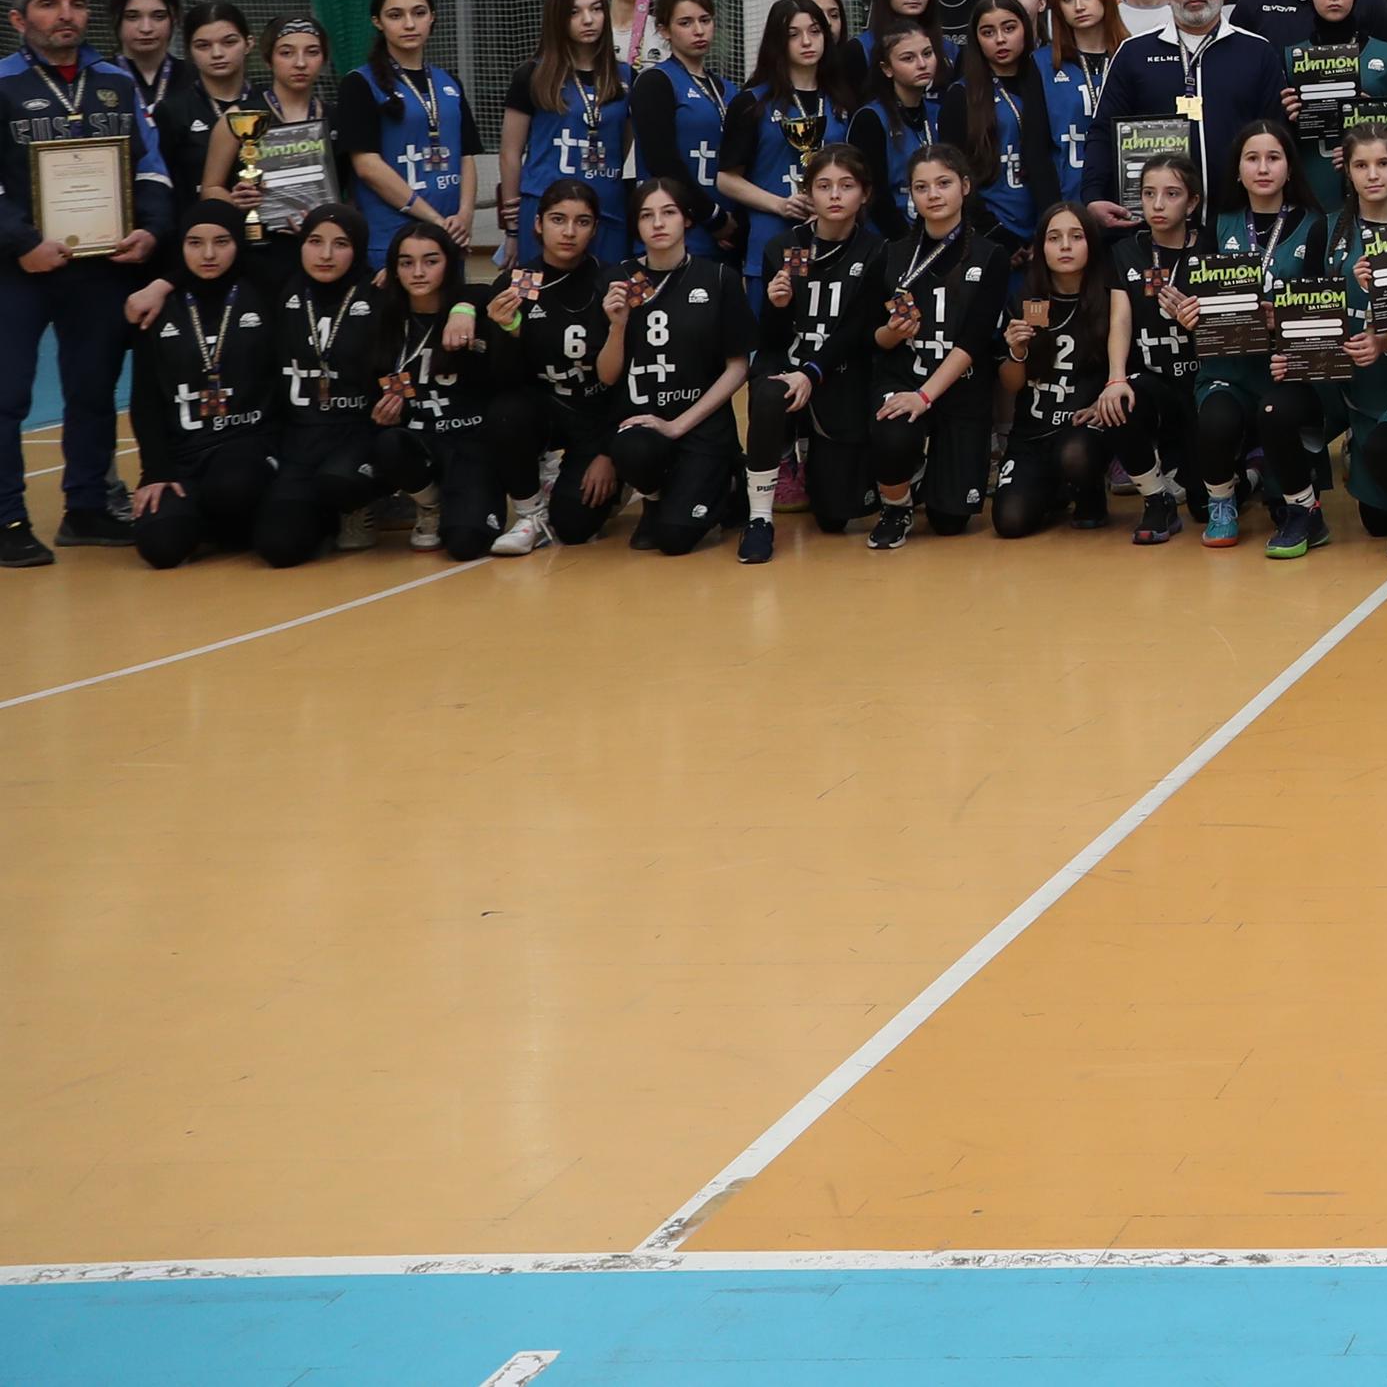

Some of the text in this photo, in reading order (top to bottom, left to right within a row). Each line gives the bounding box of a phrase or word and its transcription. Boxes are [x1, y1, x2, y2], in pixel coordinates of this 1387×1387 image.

[1146, 55, 1181, 63] KELME
[1294, 52, 1359, 74] ДИПЛОМ
[1122, 128, 1189, 151] ДИПЛОМ
[1189, 260, 1262, 284] ДИПЛОМ
[808, 280, 842, 317] 11
[933, 286, 947, 324] 1
[1274, 283, 1346, 309] ДИПЛОМ
[646, 310, 670, 347] 8
[564, 325, 587, 358] 6
[1056, 334, 1075, 371] 2
[657, 387, 701, 407] group
[213, 408, 262, 431] group
[435, 414, 483, 434] group
